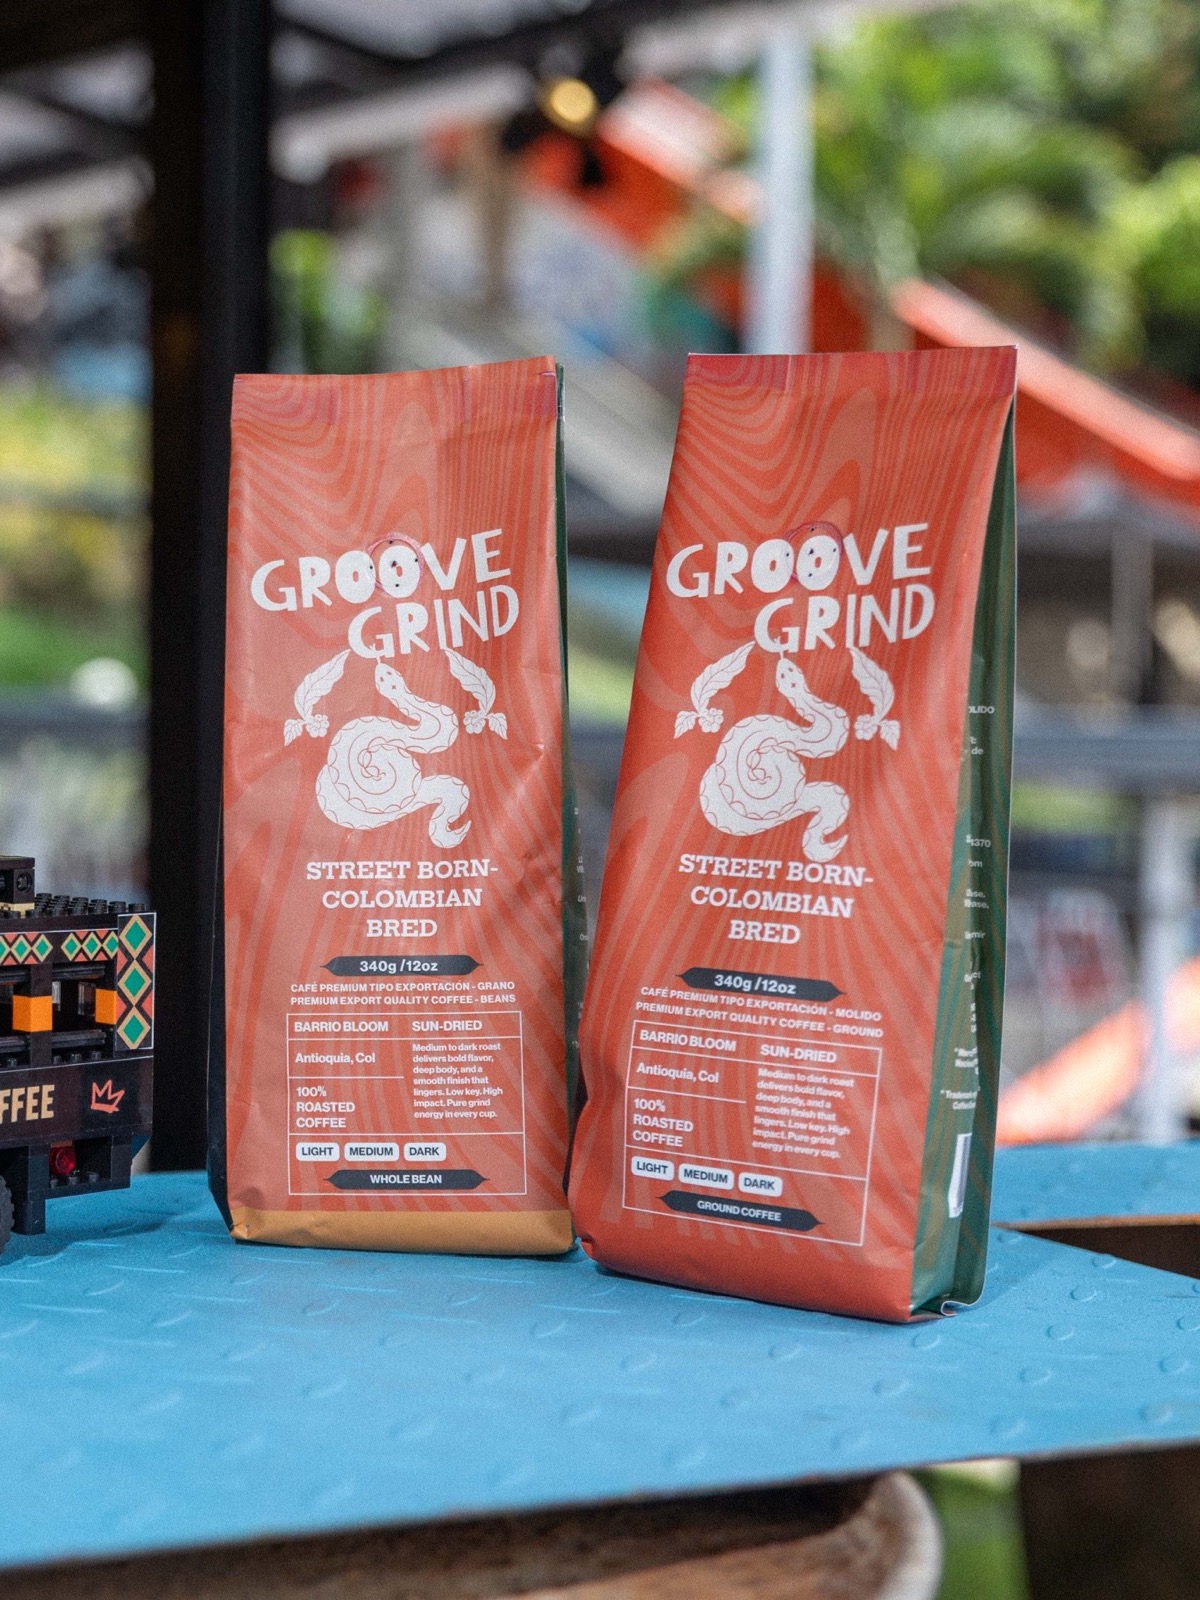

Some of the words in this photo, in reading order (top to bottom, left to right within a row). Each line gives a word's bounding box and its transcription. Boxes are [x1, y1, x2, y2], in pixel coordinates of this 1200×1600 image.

[666, 523, 932, 598] GROOVE
[251, 528, 511, 612] GROOVE
[348, 585, 519, 658] GRIND
[754, 584, 935, 653] GRIND
[306, 861, 411, 880] STREET
[417, 859, 498, 878] BORN-
[679, 854, 781, 879] STREET
[786, 860, 873, 887] BORN-
[322, 888, 482, 909] COLOMBIAN
[690, 885, 854, 918] COLOMBIAN
[366, 919, 438, 938] BRED
[728, 920, 800, 945] BRED
[360, 961, 397, 974] 340g
[400, 959, 438, 972] /12oz
[291, 981, 317, 992] CAFÉ
[320, 983, 367, 992] PREMIUM
[369, 983, 394, 992] TIPO
[396, 980, 470, 992] EXPORTACIÓN
[478, 981, 515, 990] GRANO
[714, 974, 751, 991] 340g
[754, 977, 796, 994] /12oz
[291, 997, 340, 1006] PREMIUM
[342, 996, 382, 1006] EXPORT
[383, 996, 428, 1006] QUALITY
[431, 995, 473, 1004] COFFEE
[481, 994, 516, 1004] BEANS
[641, 986, 668, 997] CAFÉ
[670, 990, 718, 1004] PREMIUM
[720, 995, 745, 1007] TIPO
[746, 998, 828, 1016] EXPORTACIÓN
[836, 1008, 882, 1022] MOLIDO
[294, 1021, 341, 1032] BARRIO
[342, 1021, 388, 1032] BLOOM
[412, 1020, 482, 1032] SUN-DRIED
[636, 1002, 683, 1016] PREMIUM
[685, 1007, 728, 1020] EXPORT
[729, 1012, 776, 1026] QUALITY
[779, 1018, 825, 1031] COFFEE
[833, 1024, 884, 1038] GROUND
[412, 1044, 447, 1052] Medium
[458, 1043, 478, 1051] dark
[640, 1030, 688, 1046] BARRIO
[689, 1035, 736, 1052] BLOOM
[295, 1052, 354, 1066] Antioquia,
[356, 1052, 376, 1064] Col
[448, 1054, 466, 1062] bold
[760, 1044, 837, 1063] SUN-DRIED
[413, 1066, 434, 1075] deep
[460, 1065, 476, 1073] and
[636, 1062, 696, 1082] Antioquia,
[698, 1070, 720, 1084] Col
[447, 1076, 470, 1084] finish
[471, 1076, 489, 1084] that
[296, 1085, 327, 1098] 100%
[446, 1088, 464, 1096] Low
[482, 1087, 504, 1096] High
[296, 1102, 356, 1113] ROASTED
[468, 1098, 490, 1108] grind
[633, 1098, 666, 1113] 100%
[296, 1118, 346, 1128] COFFEE
[414, 1111, 444, 1119] energy
[445, 1110, 454, 1118] in
[454, 1111, 478, 1119] every
[633, 1114, 694, 1132] ROASTED
[632, 1130, 684, 1148] COFFEE
[302, 1147, 334, 1157] LIGHT
[349, 1146, 394, 1156] MEDIUM
[408, 1146, 440, 1156] DARK
[370, 1174, 410, 1184] WHOLE
[412, 1174, 442, 1184] BEAN
[636, 1161, 668, 1176] LIGHT
[683, 1168, 728, 1185] MEDIUM
[743, 1177, 776, 1191] DARK
[696, 1200, 740, 1216] GROUND
[741, 1206, 782, 1222] COFFEE
